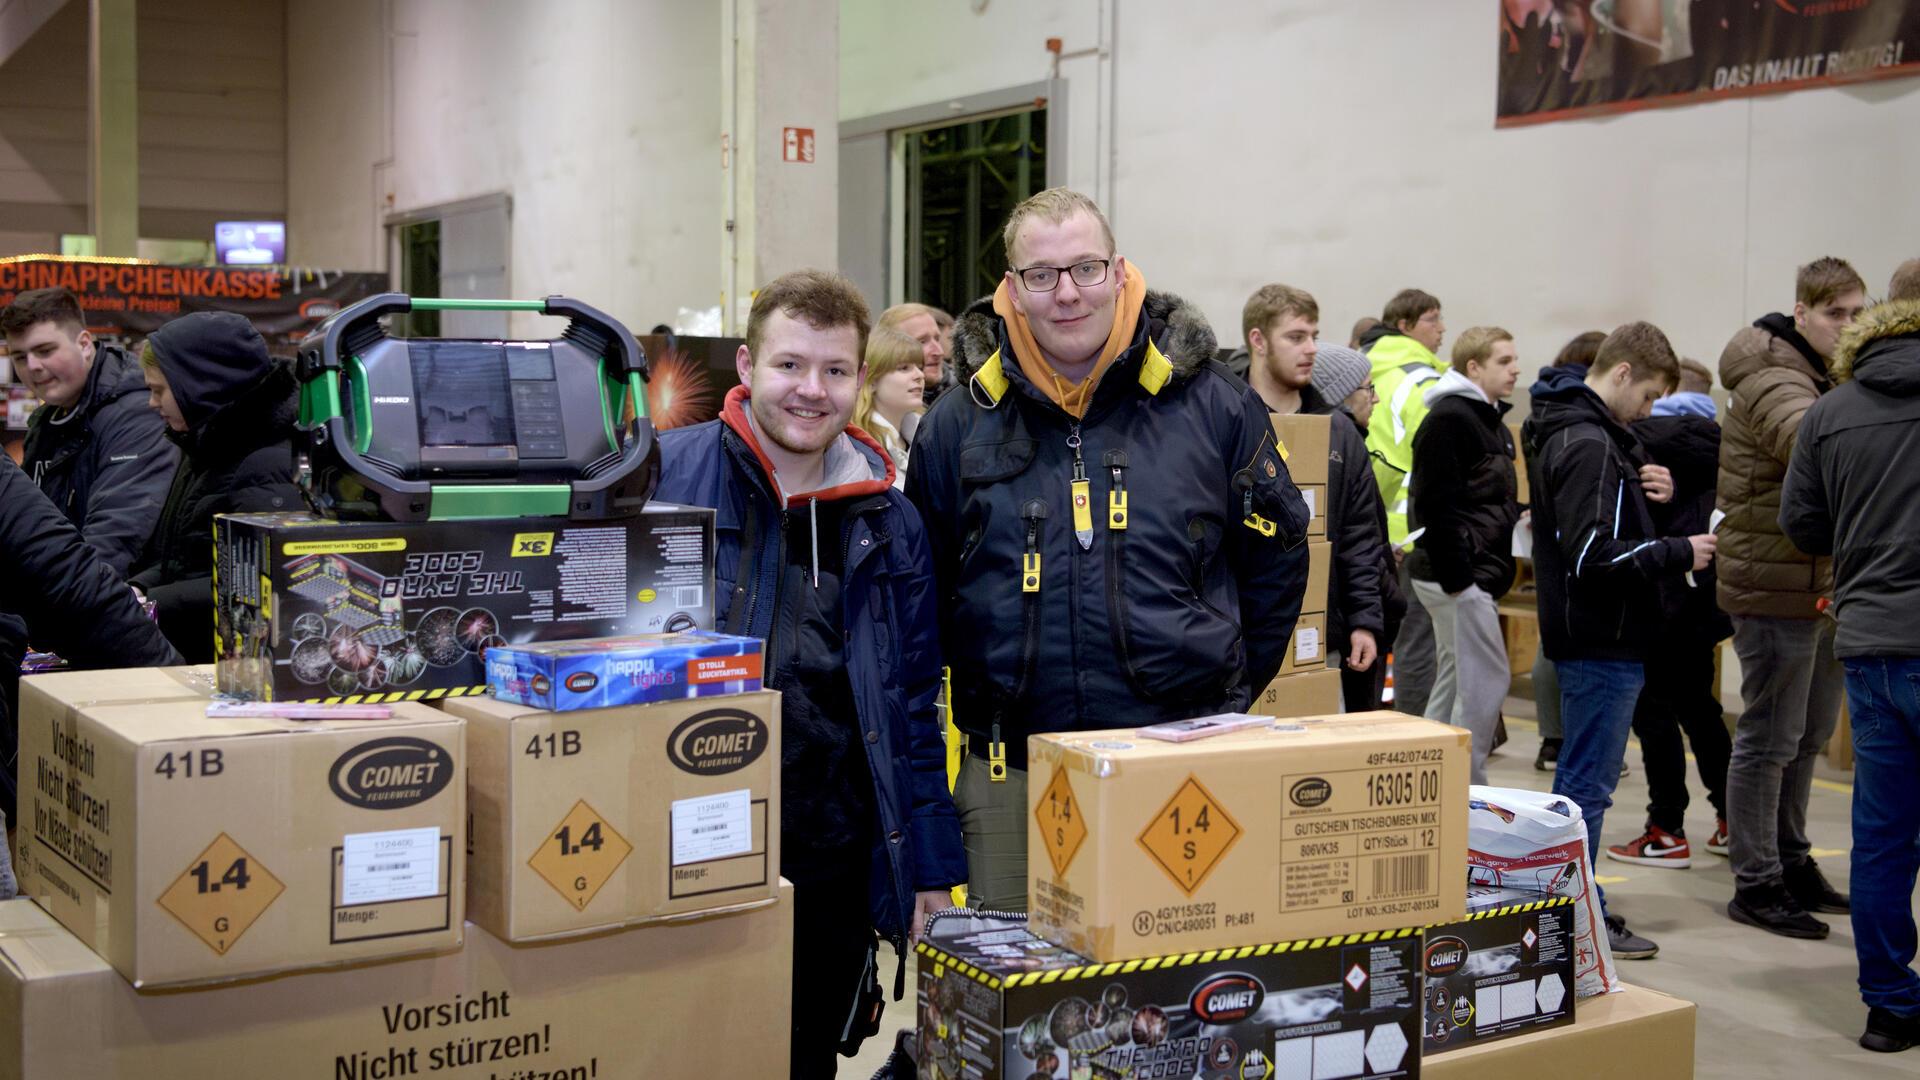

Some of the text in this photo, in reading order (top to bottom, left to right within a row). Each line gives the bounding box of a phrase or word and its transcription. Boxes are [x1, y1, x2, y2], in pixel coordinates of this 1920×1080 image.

[1714, 41, 1904, 90] DAS KNALLT RICHTIG!
[605, 657, 655, 677] happy
[697, 668, 748, 680] LEUCHTARTIKEL
[707, 660, 726, 670] TOLLE
[630, 671, 676, 690] lights
[52, 719, 95, 779] Vorsicht
[525, 730, 582, 760] 41B
[692, 731, 758, 757] COMET
[155, 748, 224, 780] 41B
[697, 756, 743, 769] FEUERWERK
[1366, 748, 1444, 766] 49F442/074/22
[360, 762, 440, 789] COMET
[37, 755, 110, 836] Nicht stürzen!
[366, 789, 422, 802] FEUERWERK
[1366, 769, 1438, 807] 16305 00
[1050, 789, 1071, 824] 1.4
[1169, 804, 1210, 835] 1.4
[1294, 811, 1437, 836] GUTSCHEIN TISCHBOMBEN MIX
[34, 797, 47, 837] Vor
[48, 806, 72, 858] Nässe
[73, 830, 113, 887] schützen!
[554, 822, 604, 856] 1.4
[1055, 826, 1065, 847] S
[1363, 829, 1435, 850] QTY/Stück 12
[1183, 840, 1196, 860] S
[190, 857, 251, 894] 1.4
[574, 876, 588, 892] G
[674, 867, 709, 881] Menge:
[1186, 867, 1192, 882] 1
[577, 896, 584, 907] 1
[337, 908, 379, 925] Menge:
[1347, 907, 1363, 919] LOT
[214, 916, 229, 933] G
[218, 939, 225, 951] 1
[1429, 950, 1463, 967] COMET
[1208, 990, 1257, 1013] COMET
[381, 990, 511, 1035] Vorsicht
[335, 1046, 418, 1080] Nicht
[429, 1023, 551, 1071] stürzen!
[1106, 1048, 1145, 1067] THE
